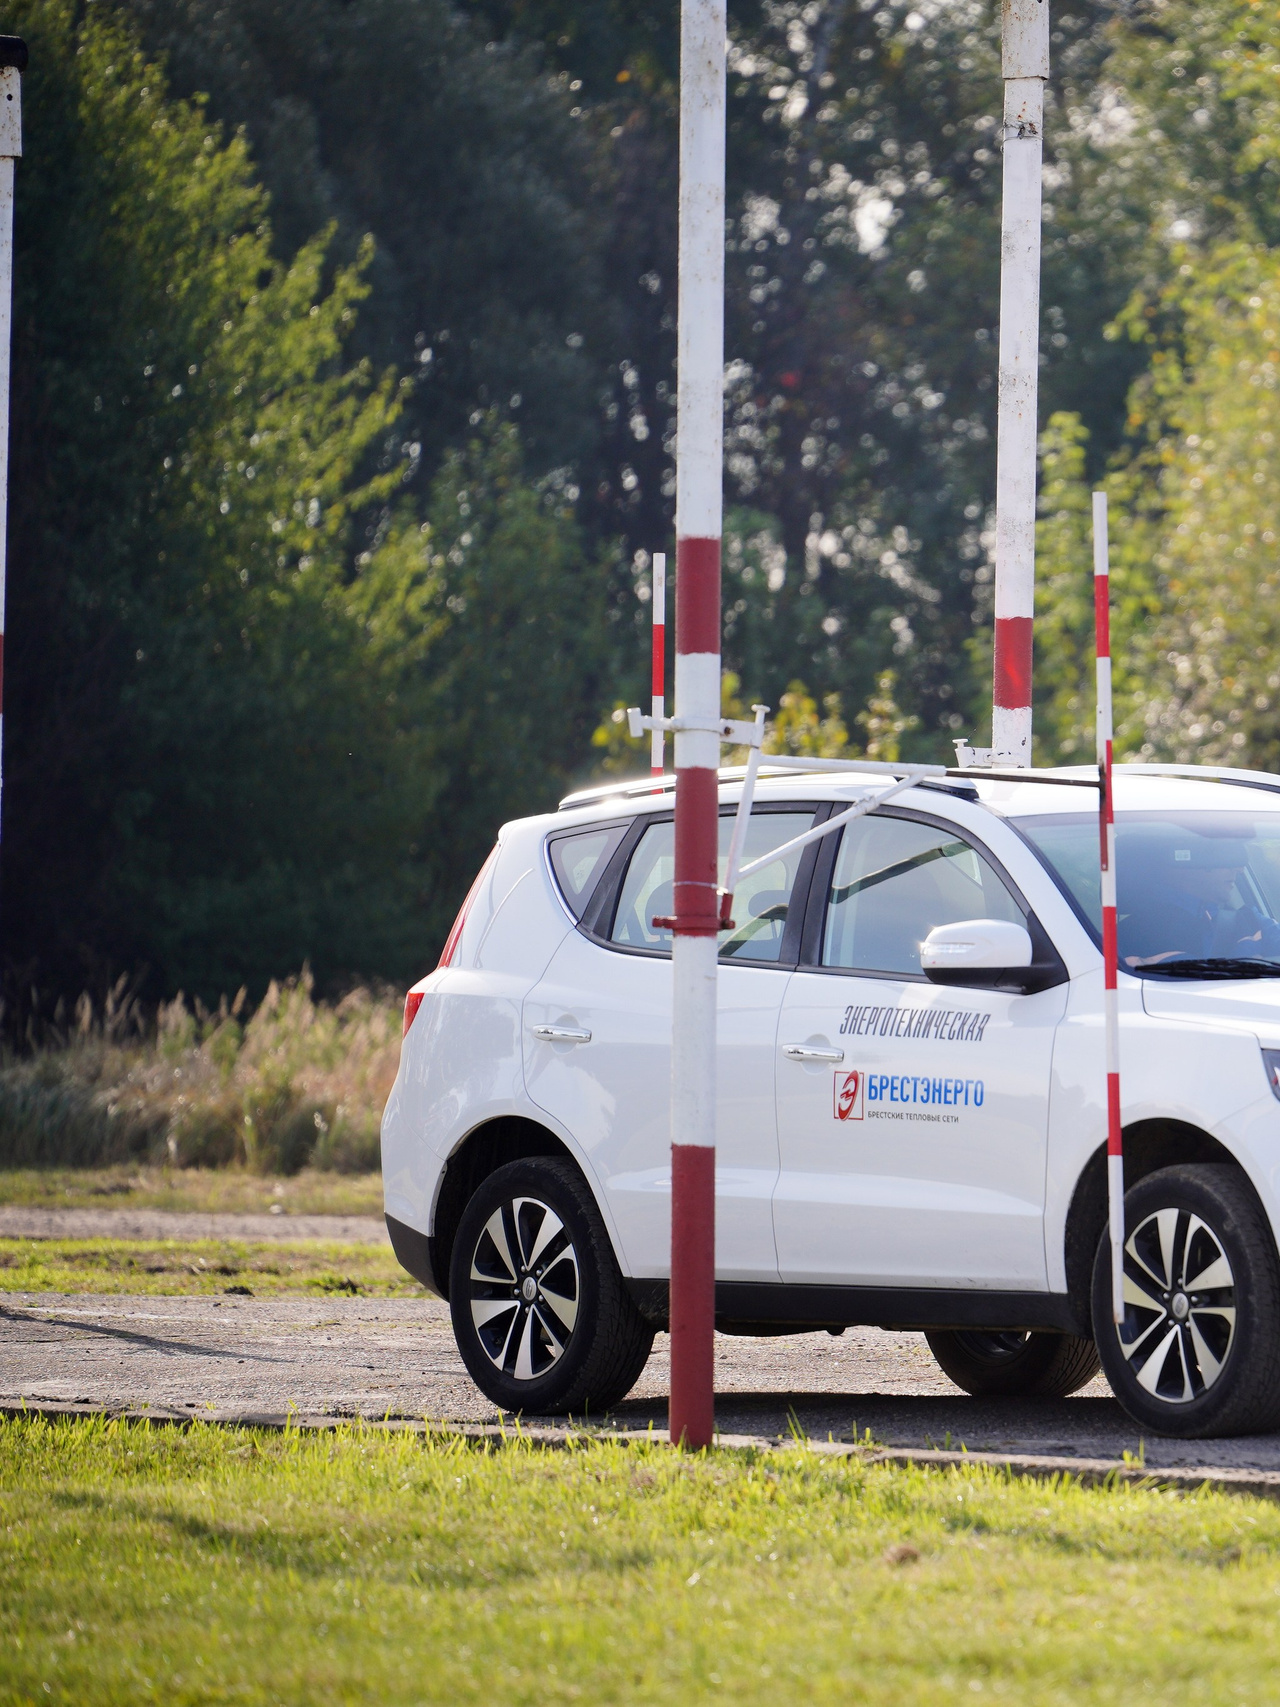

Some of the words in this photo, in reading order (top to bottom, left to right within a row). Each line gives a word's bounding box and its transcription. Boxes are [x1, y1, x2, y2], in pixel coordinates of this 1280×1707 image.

[839, 1005, 991, 1042] ЭНЕРГОТЕХНИЧЕСКАЯ
[868, 1074, 985, 1107] БРЕСТЭНЕРГО
[867, 1110, 904, 1120] БРЕСТСКИЕ
[905, 1112, 941, 1122] ТЕПЛОВЫЕ
[942, 1115, 959, 1123] СЕТИ
